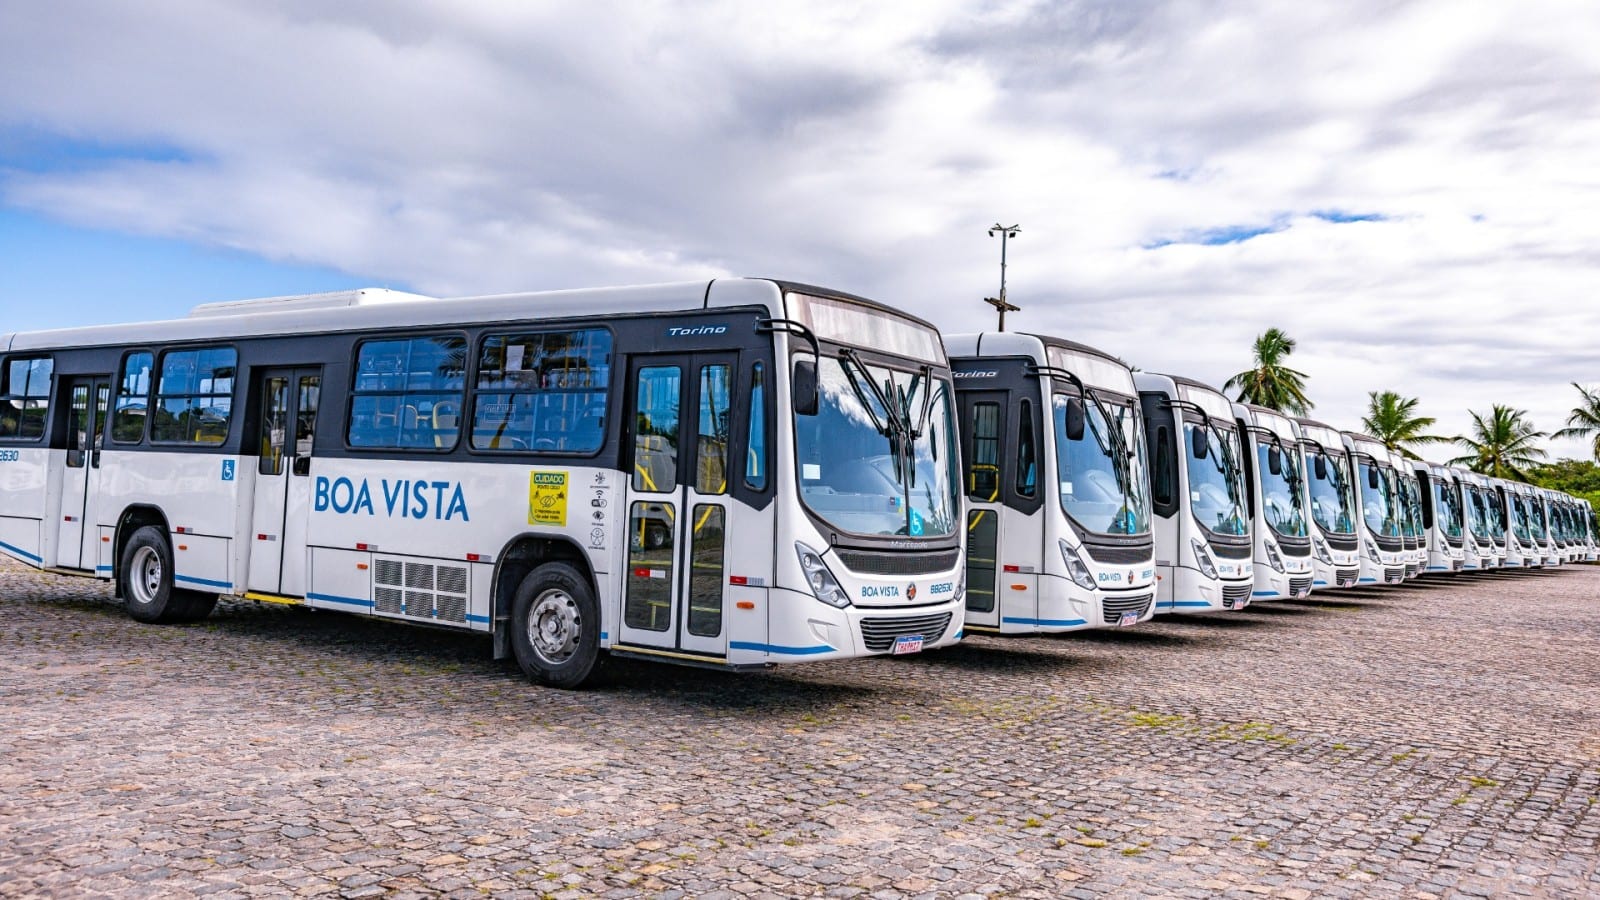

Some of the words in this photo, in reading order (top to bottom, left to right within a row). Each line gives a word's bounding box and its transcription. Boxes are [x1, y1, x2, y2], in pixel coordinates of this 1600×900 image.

[669, 325, 727, 336] Torino
[534, 474, 564, 484] CUIDADO
[315, 476, 374, 515] BOA
[382, 479, 469, 522] VISTA
[861, 586, 878, 597] BOA
[880, 586, 899, 597] VISTA
